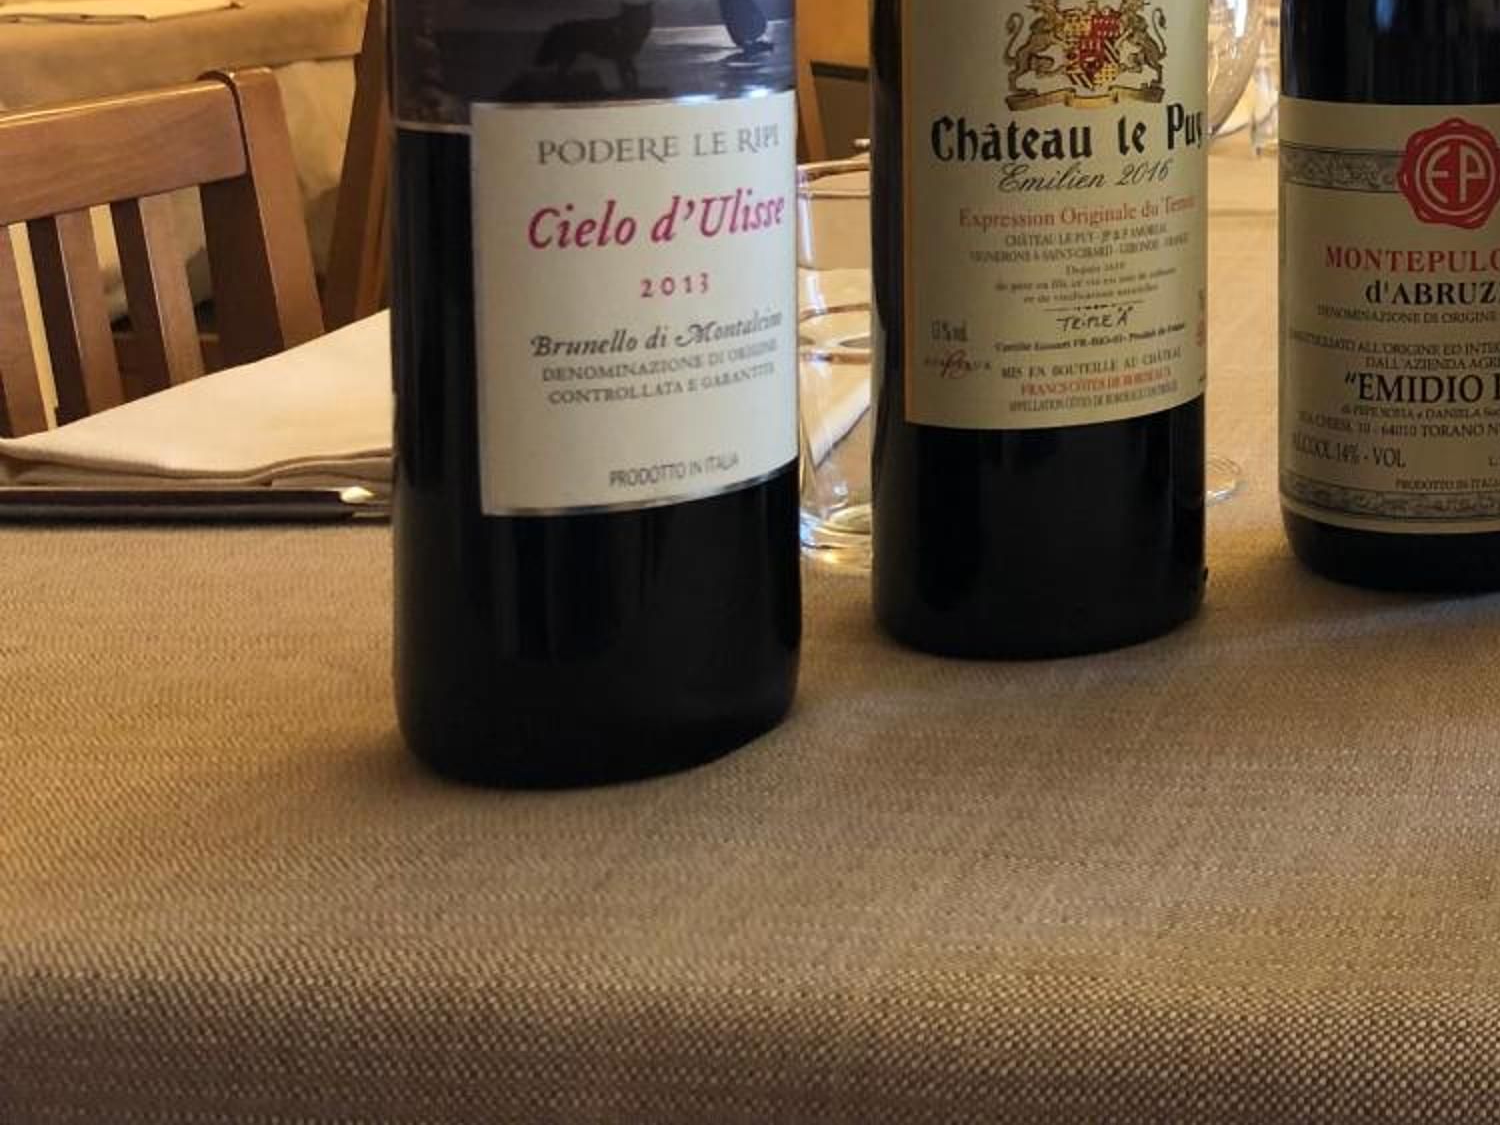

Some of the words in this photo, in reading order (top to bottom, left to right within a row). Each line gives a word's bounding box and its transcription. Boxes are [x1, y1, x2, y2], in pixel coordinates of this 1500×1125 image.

[537, 135, 680, 165] PODERE
[694, 131, 729, 156] LE
[737, 123, 780, 154] RIPI
[930, 114, 1093, 162] Château
[1118, 114, 1146, 156] le
[998, 162, 1107, 194] Emilien
[1114, 159, 1174, 187] 2016
[528, 199, 637, 248] Cielo
[959, 207, 1056, 232] Expression
[1060, 200, 1137, 227] Originale
[639, 272, 711, 298] 2013
[530, 328, 638, 357] Brunello
[645, 324, 668, 350] di
[542, 353, 704, 383] DENOMINAZIONE
[708, 350, 725, 366] DI
[548, 379, 684, 405] CONTROLLATA
[688, 376, 699, 392] E
[1421, 423, 1485, 438] TORANO
[608, 462, 687, 488] PRODOTTO
[690, 459, 702, 474] IN
